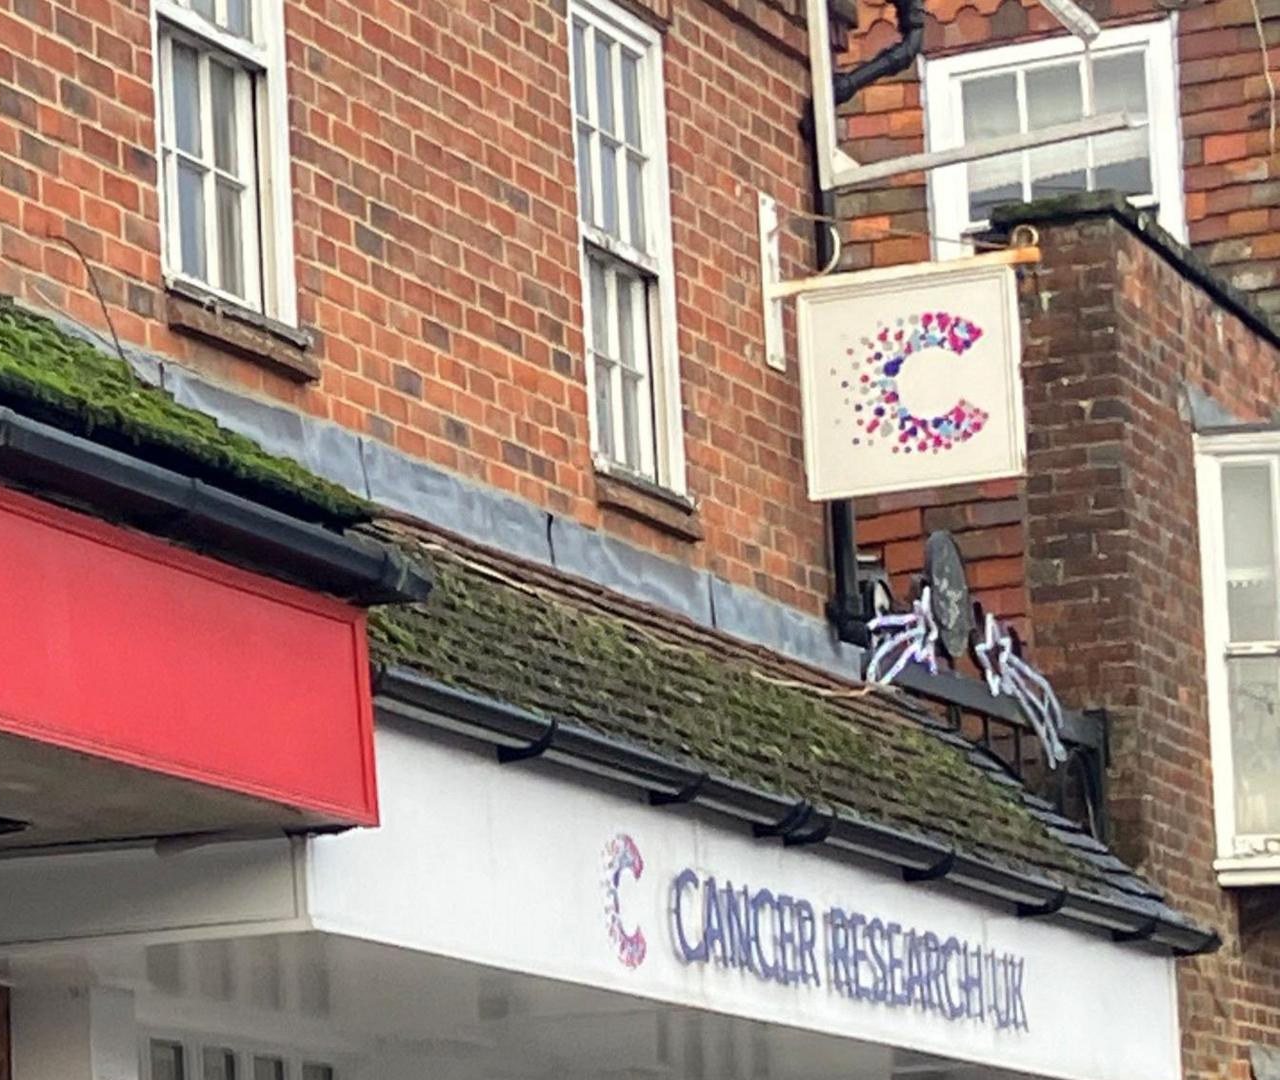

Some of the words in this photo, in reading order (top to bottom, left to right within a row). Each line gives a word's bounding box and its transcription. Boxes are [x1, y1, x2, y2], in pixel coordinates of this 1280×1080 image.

[670, 868, 822, 989] CANCER
[824, 906, 983, 1025] RESEARCH
[985, 950, 1030, 1034] UK
